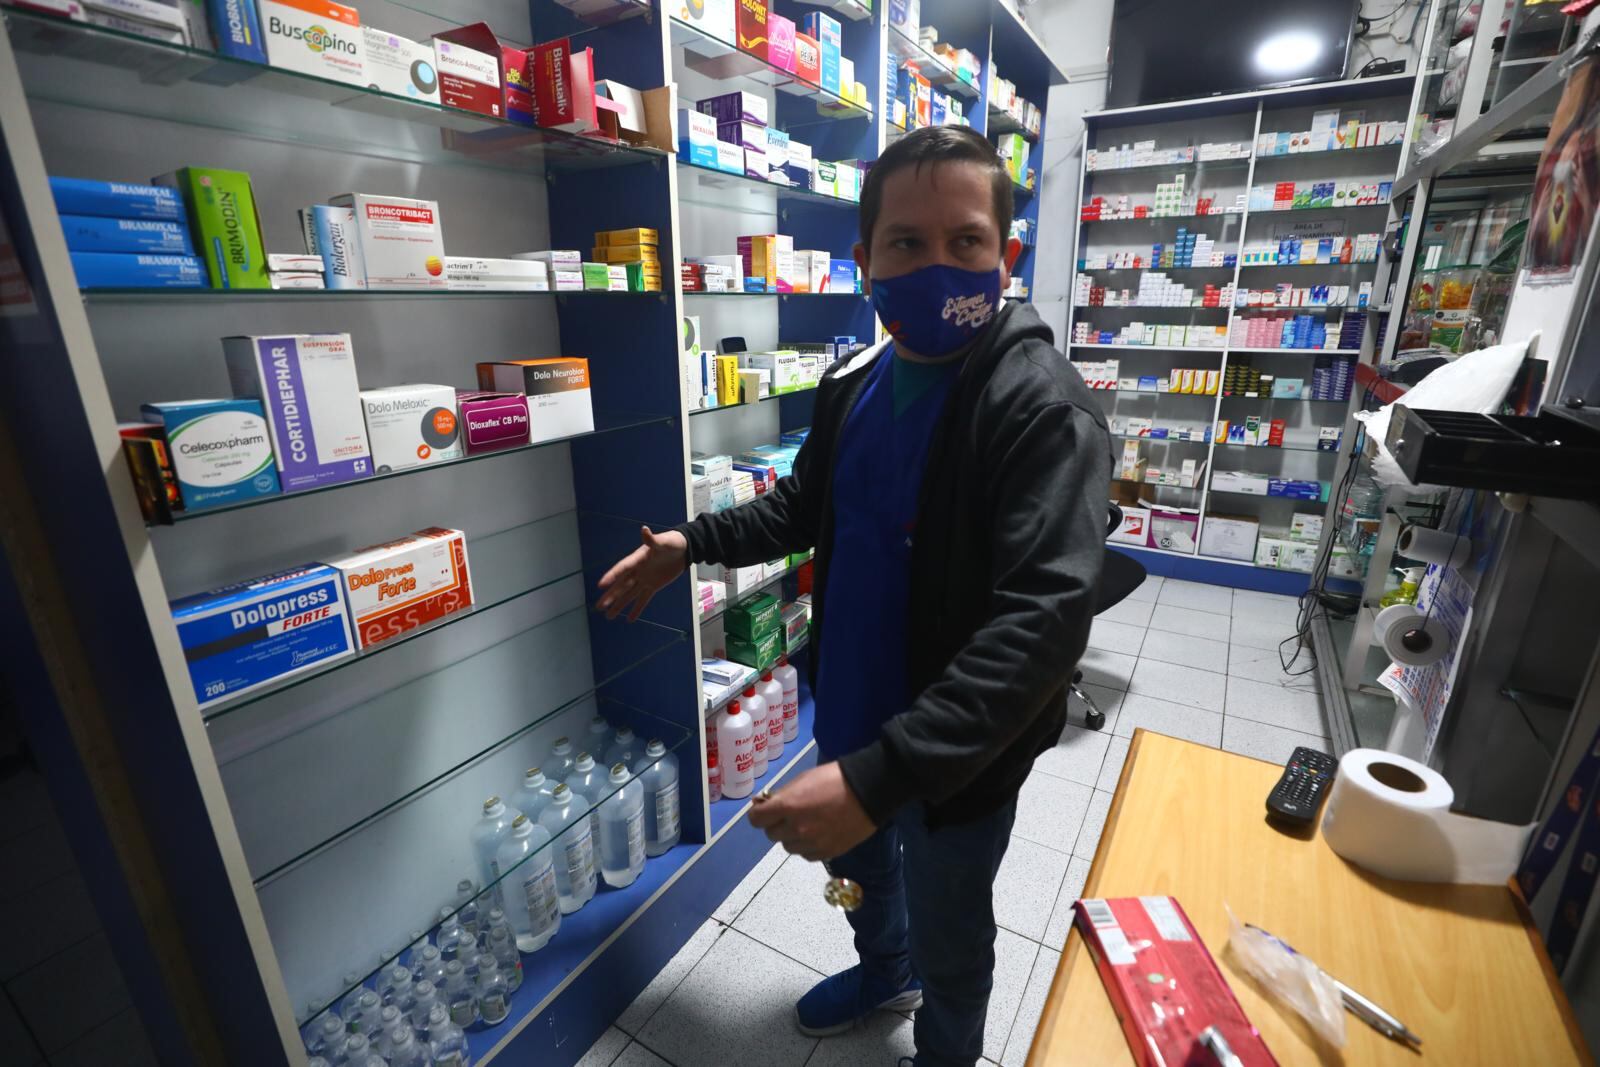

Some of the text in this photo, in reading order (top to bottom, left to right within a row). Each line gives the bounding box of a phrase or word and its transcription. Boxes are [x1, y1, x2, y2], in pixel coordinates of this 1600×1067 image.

[269, 16, 357, 55] Buscapina
[111, 183, 175, 198] BRAMOXAL
[155, 197, 176, 207] Duo
[368, 205, 431, 219] BRONCOTRIBACT
[118, 219, 181, 233] BRAMOXAL
[221, 190, 245, 265] BRIMODIN
[162, 231, 183, 241] Duo
[138, 255, 198, 267] BRAMOXAL
[179, 265, 199, 275] Duo
[533, 367, 585, 380] Dolo Neurobion
[567, 376, 585, 384] FORTE
[271, 346, 307, 463] CORTIDIEPHAR
[368, 398, 428, 414] Dolo Meloxic
[470, 413, 527, 430] Dioxaflex CB Plus
[179, 434, 265, 456] Celecoxpharm
[377, 576, 417, 602] Forte
[231, 588, 329, 630] Dolopress
[282, 606, 331, 631] FORTE
[205, 682, 226, 697] 200
